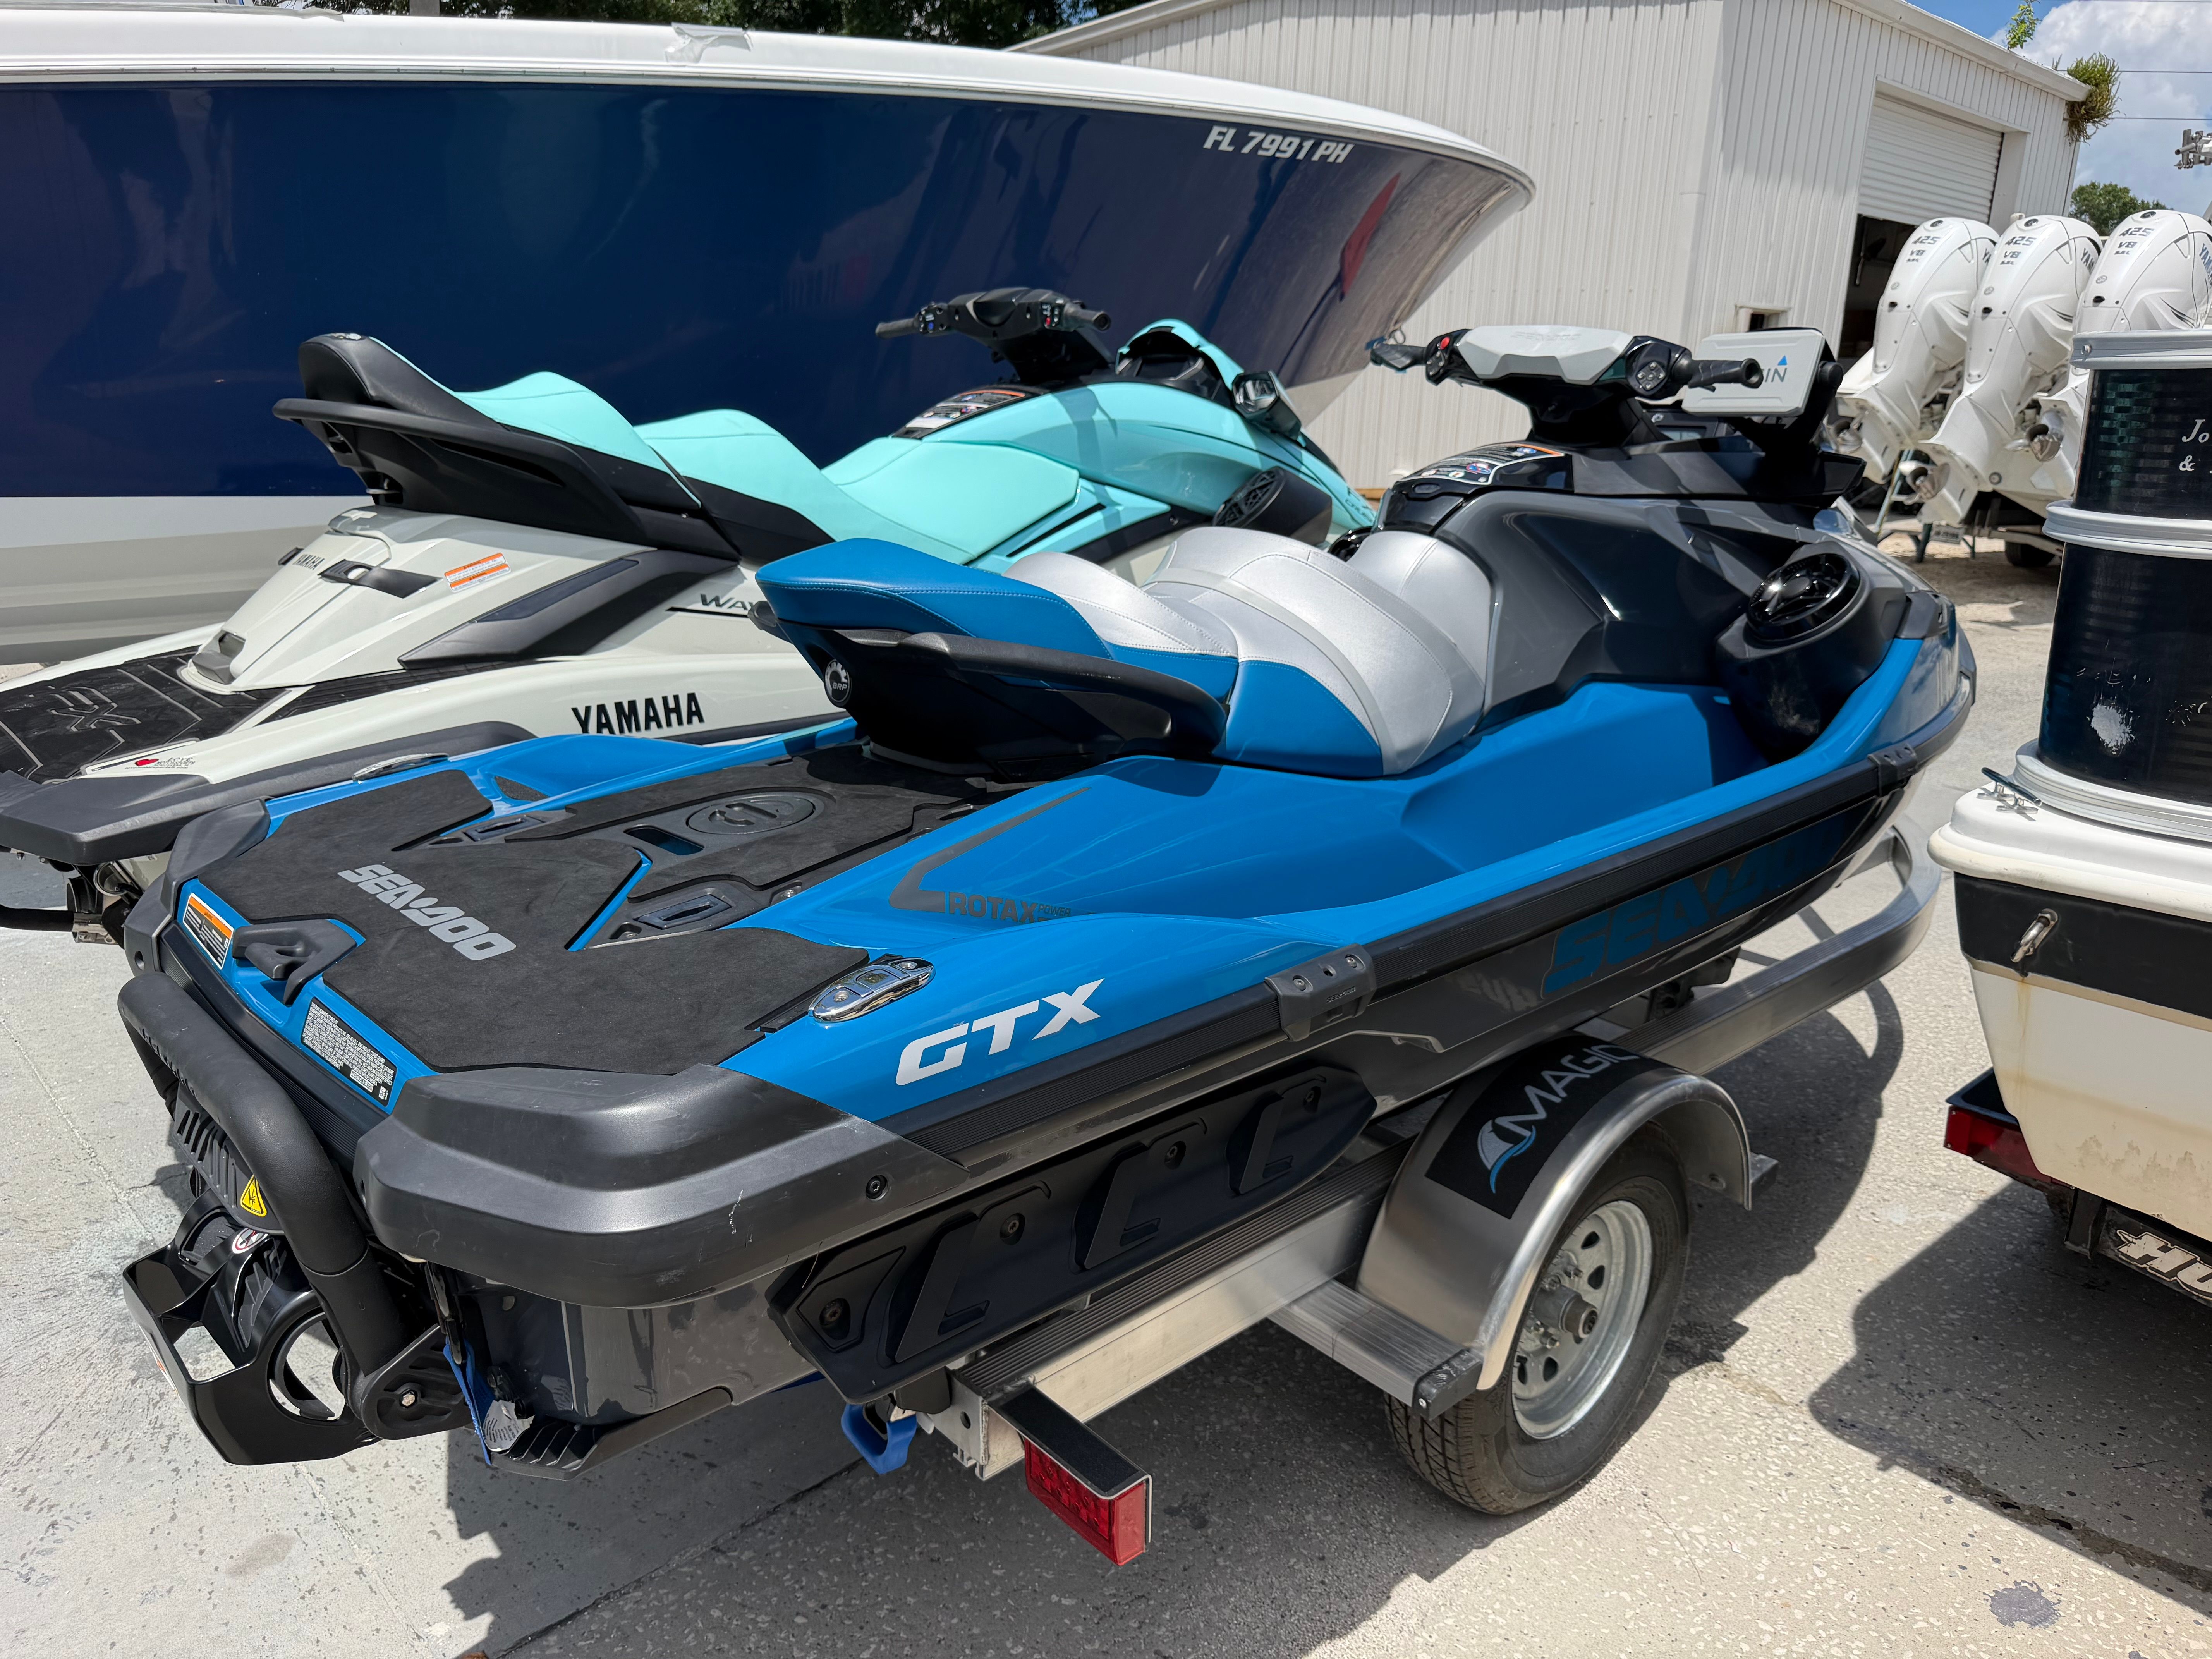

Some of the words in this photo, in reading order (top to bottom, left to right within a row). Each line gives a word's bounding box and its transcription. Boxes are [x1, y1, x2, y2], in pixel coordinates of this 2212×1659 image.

[1203, 125, 1237, 152] FL
[1240, 131, 1316, 160] 7991
[1311, 140, 1355, 163] PH
[2119, 227, 2155, 237] 425
[2004, 236, 2037, 246] 425
[1763, 368, 1788, 383] IN
[2179, 455, 2196, 472] &
[292, 554, 325, 570] YAMAHA
[833, 682, 848, 691] BRP
[571, 692, 705, 735] YAMAHA
[949, 891, 1038, 924] ROTAX
[1037, 903, 1071, 917] POWER
[896, 978, 1105, 1085] GTX
[1494, 1044, 1640, 1137] MAGIC
